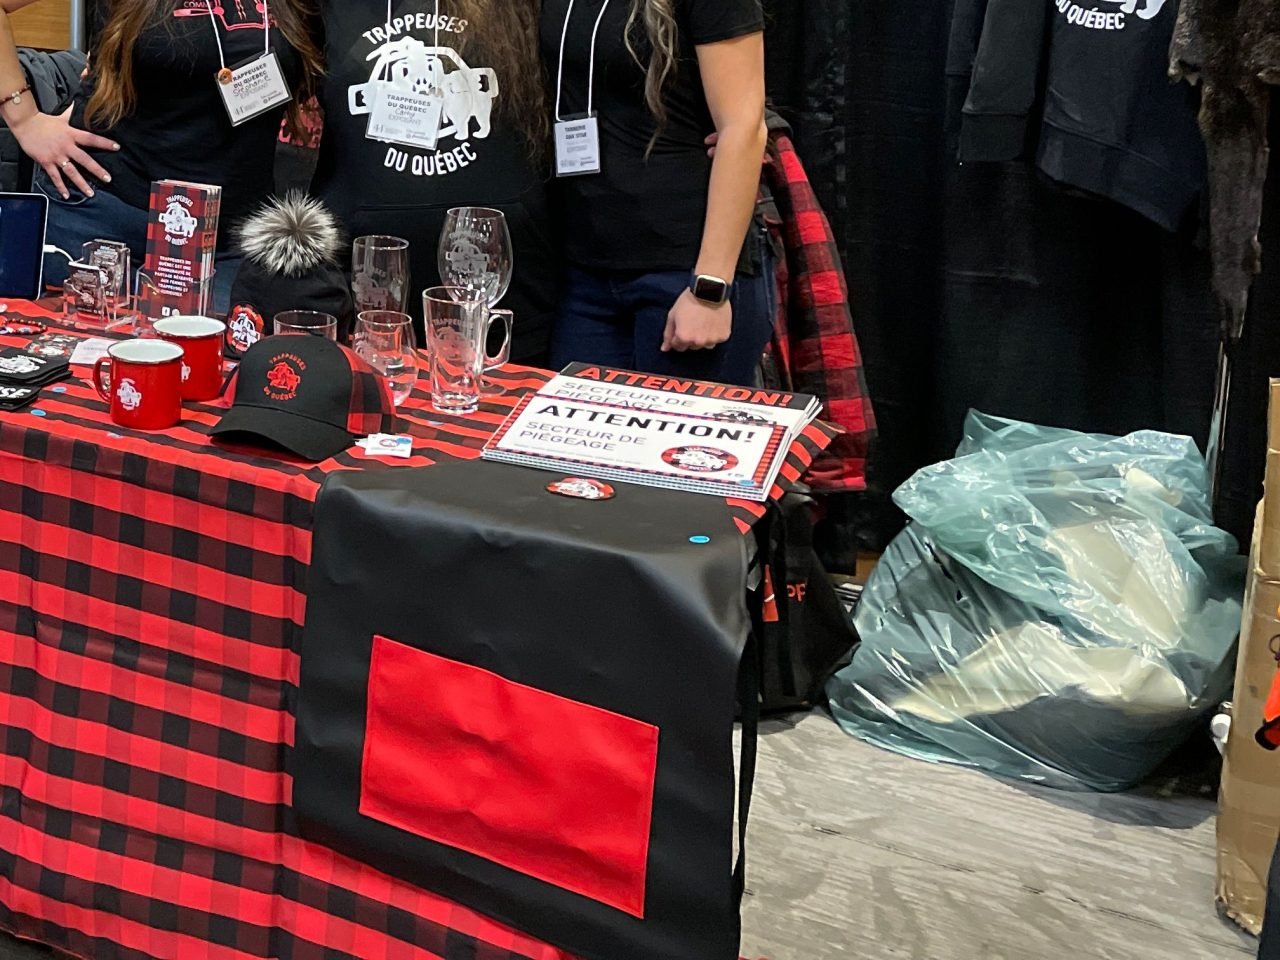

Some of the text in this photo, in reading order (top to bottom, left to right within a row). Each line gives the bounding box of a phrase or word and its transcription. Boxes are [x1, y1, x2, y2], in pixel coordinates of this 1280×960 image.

[362, 12, 469, 45] TRAPPEUSES
[1066, 6, 1126, 30] QUÉBEC
[231, 62, 268, 83] RAPPEUSES
[387, 94, 432, 107] TRAPPEUSES
[384, 141, 477, 176] DU QUÉBEC
[561, 381, 696, 407] SECTEUR DE
[576, 367, 793, 407] ATTENTION!
[526, 421, 648, 446] SECTEUR DE
[536, 404, 755, 443] ATTENTION!
[519, 429, 618, 452] PIÉGEAGE
